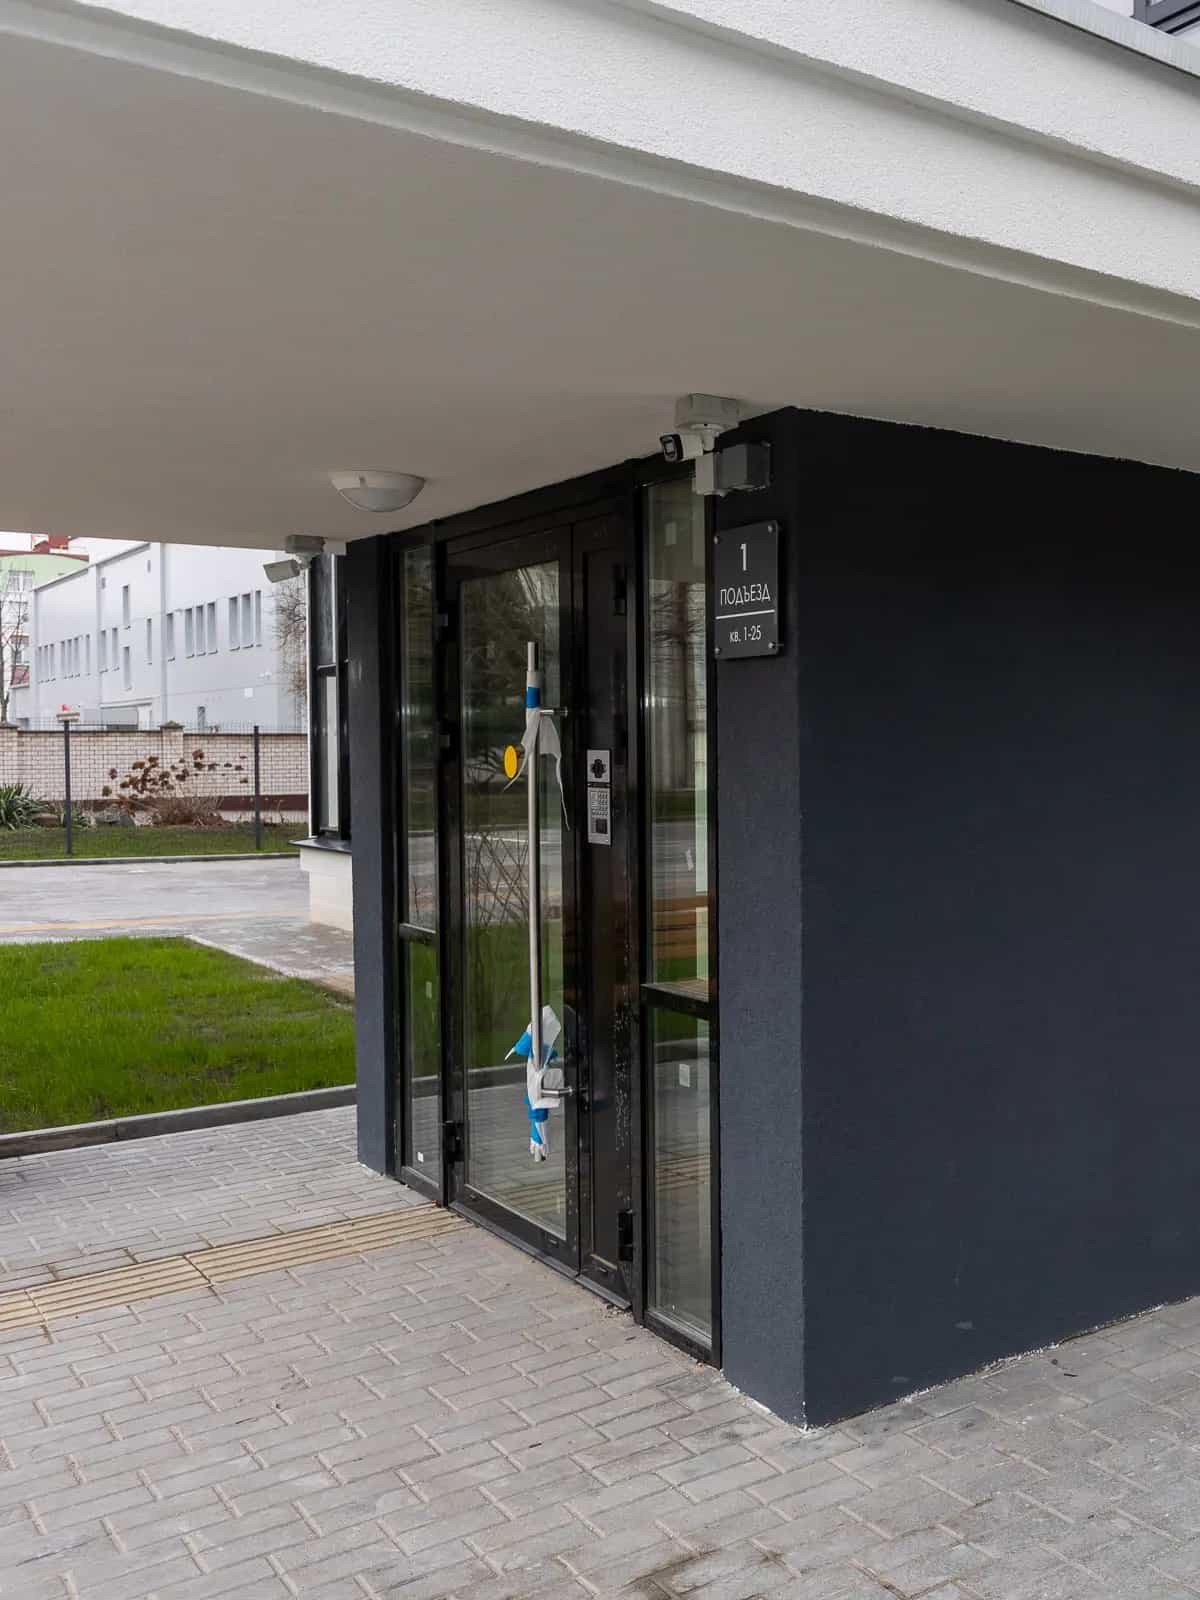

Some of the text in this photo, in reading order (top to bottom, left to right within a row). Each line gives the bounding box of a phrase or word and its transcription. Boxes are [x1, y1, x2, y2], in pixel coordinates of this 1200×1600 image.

[740, 543, 747, 571] 1
[720, 583, 771, 606] ПОДЪЕЗД
[729, 624, 762, 643] кв. 1-25
